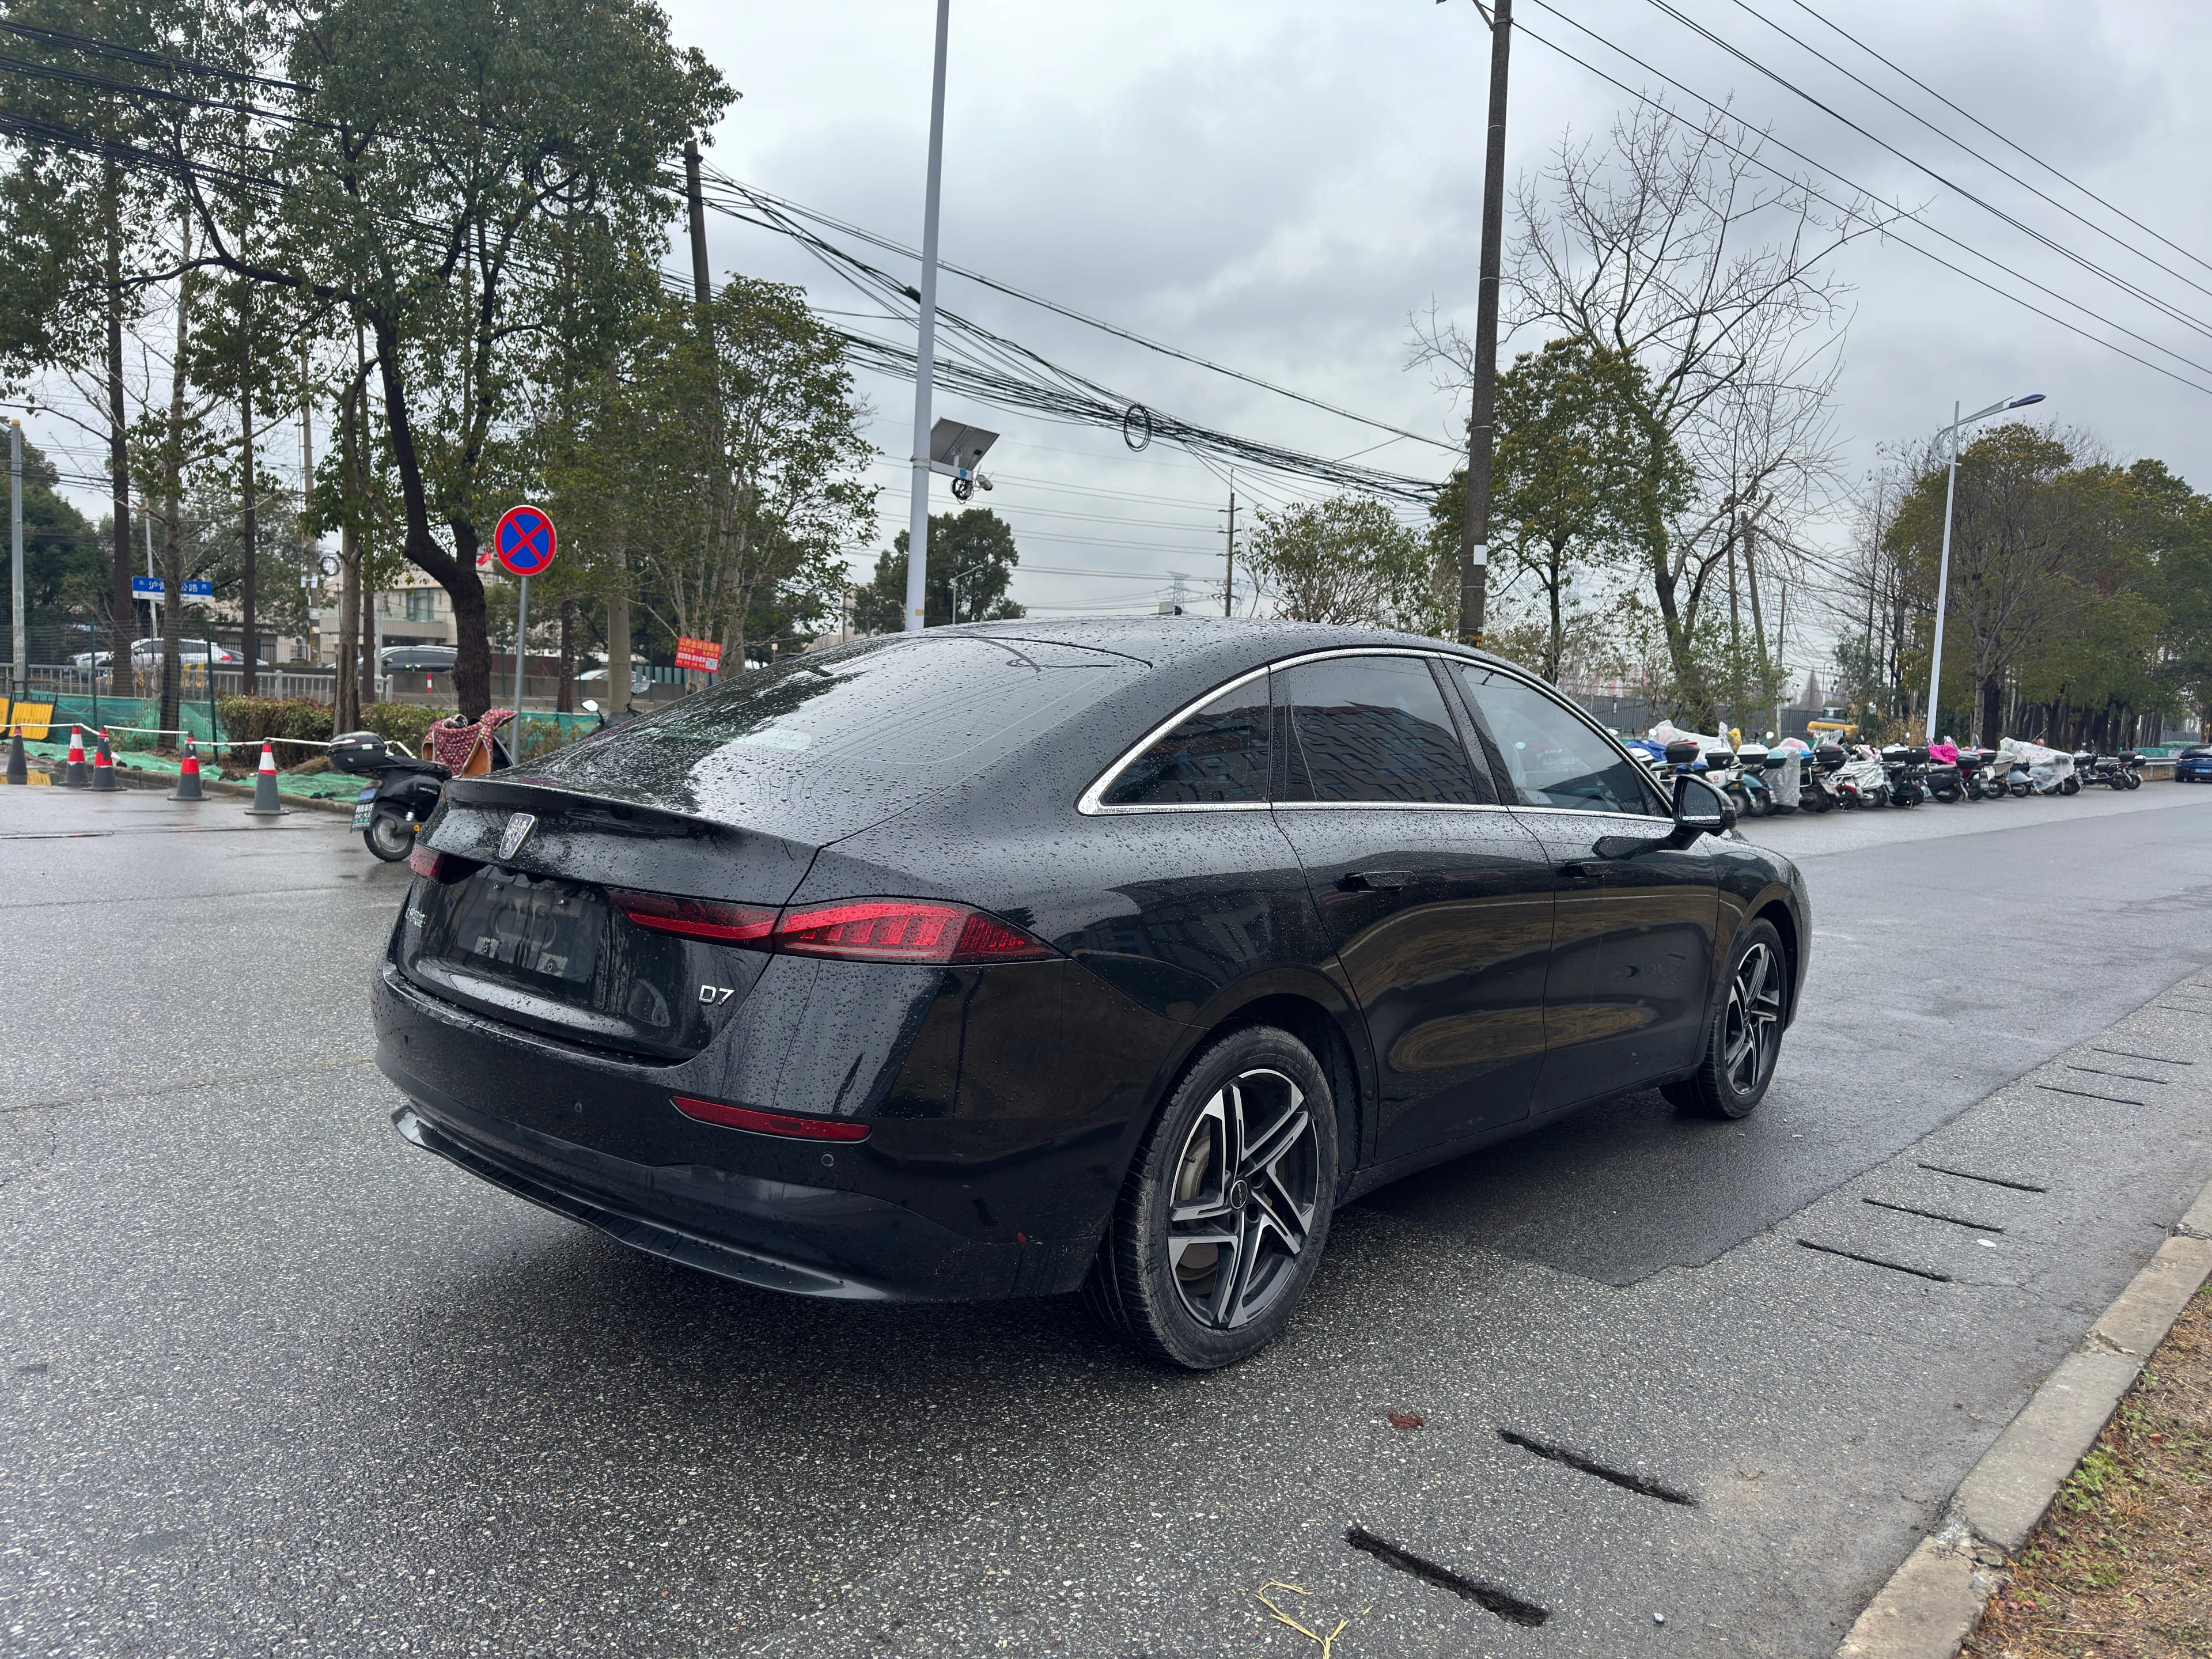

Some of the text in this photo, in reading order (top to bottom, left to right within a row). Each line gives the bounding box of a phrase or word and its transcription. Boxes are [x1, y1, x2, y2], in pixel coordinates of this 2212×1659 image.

[149, 580, 198, 593] 沪青公路
[699, 984, 735, 1005] D7
